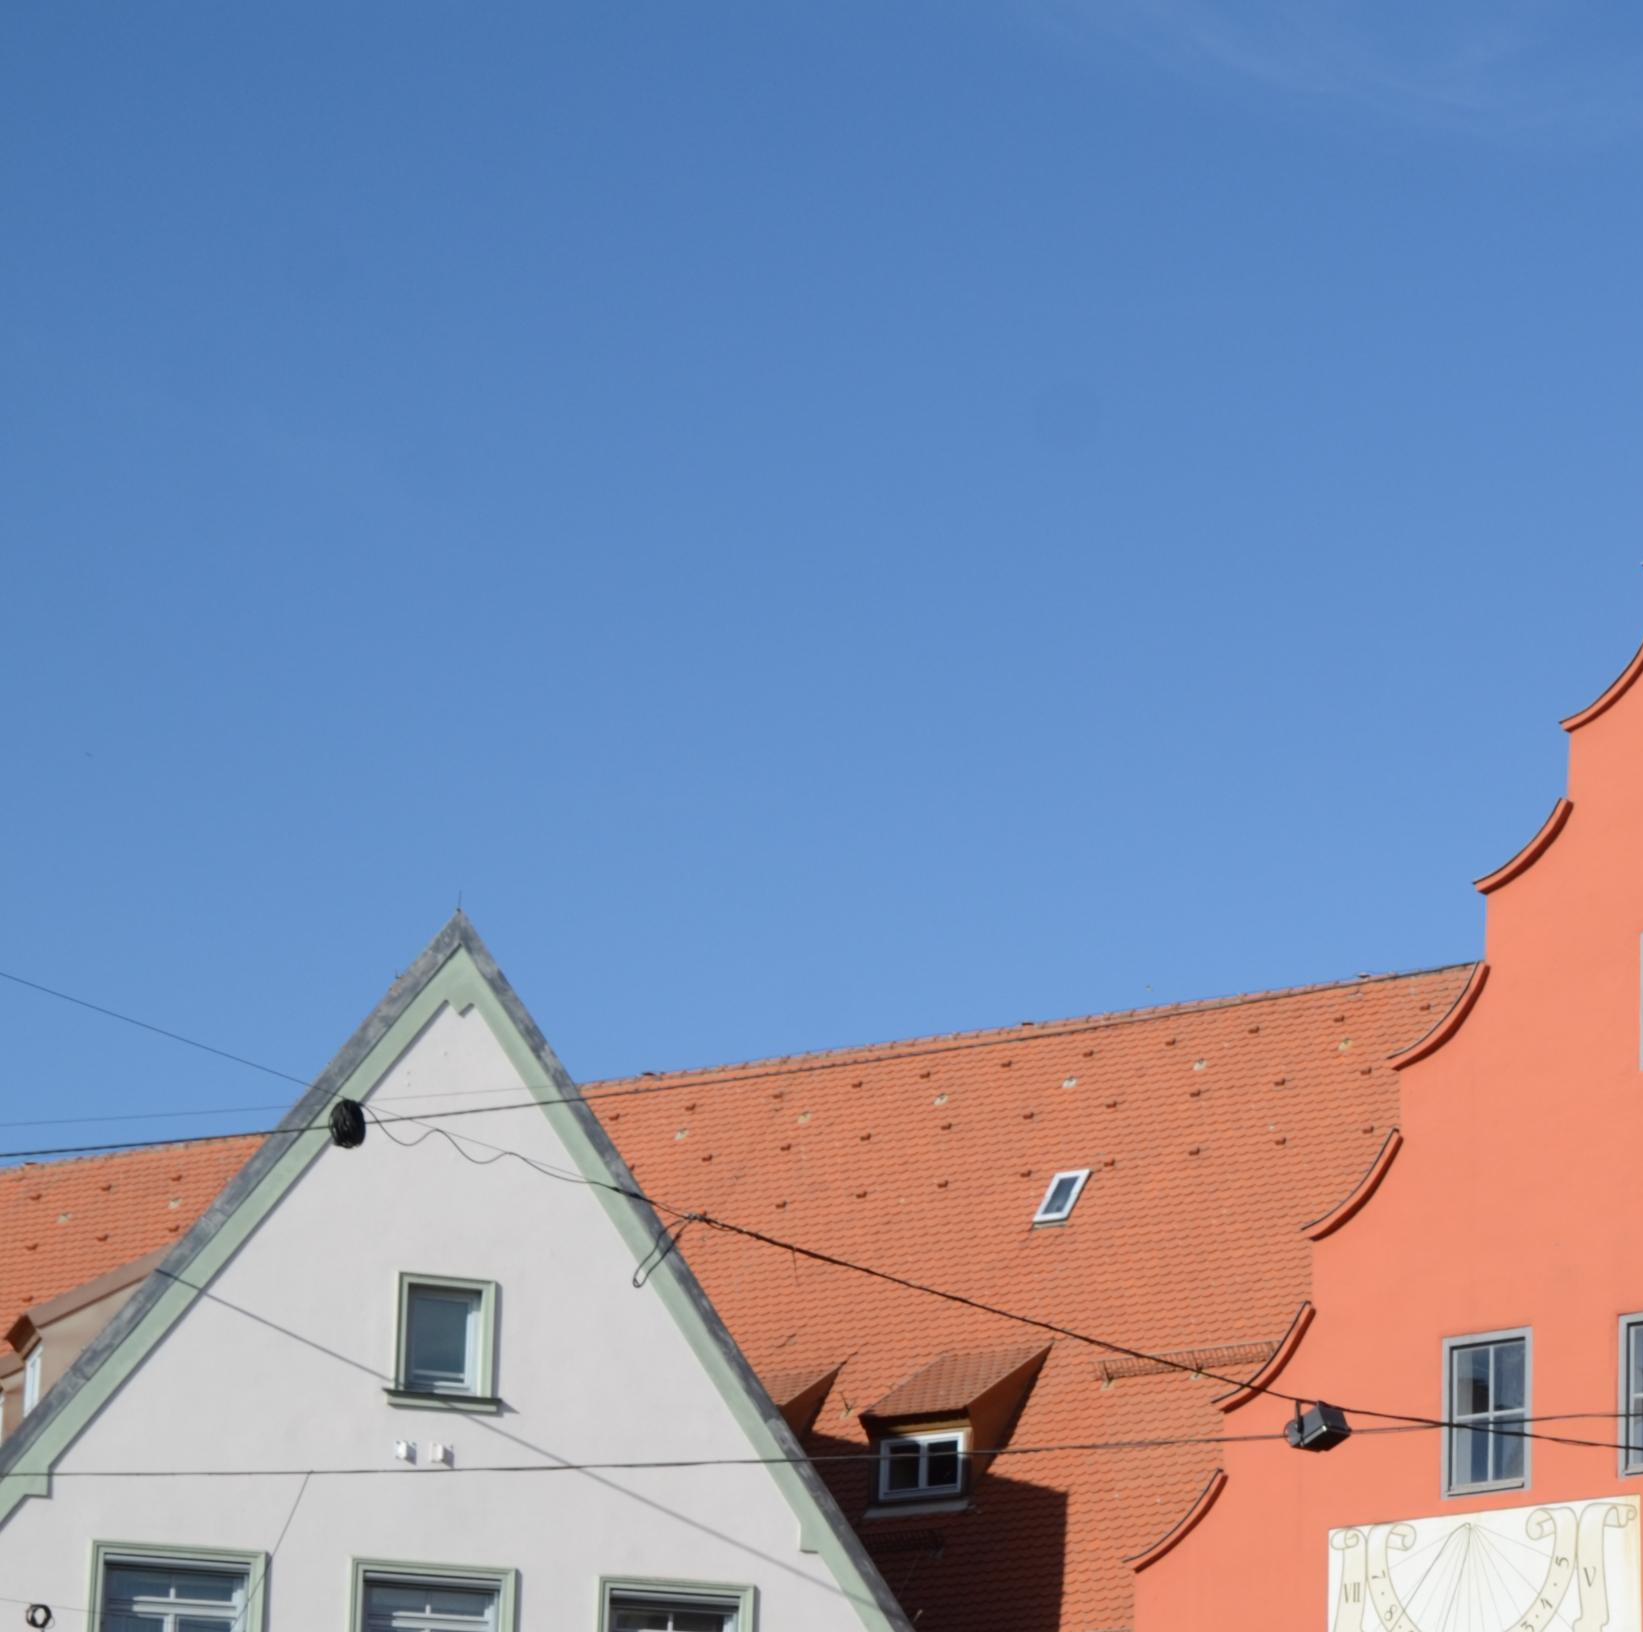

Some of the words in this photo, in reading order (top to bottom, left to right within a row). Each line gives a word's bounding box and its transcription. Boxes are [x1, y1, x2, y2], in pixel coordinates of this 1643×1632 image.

[1555, 1556, 1569, 1568] 5
[1343, 1582, 1361, 1603] VII
[1583, 1565, 1596, 1587] V
